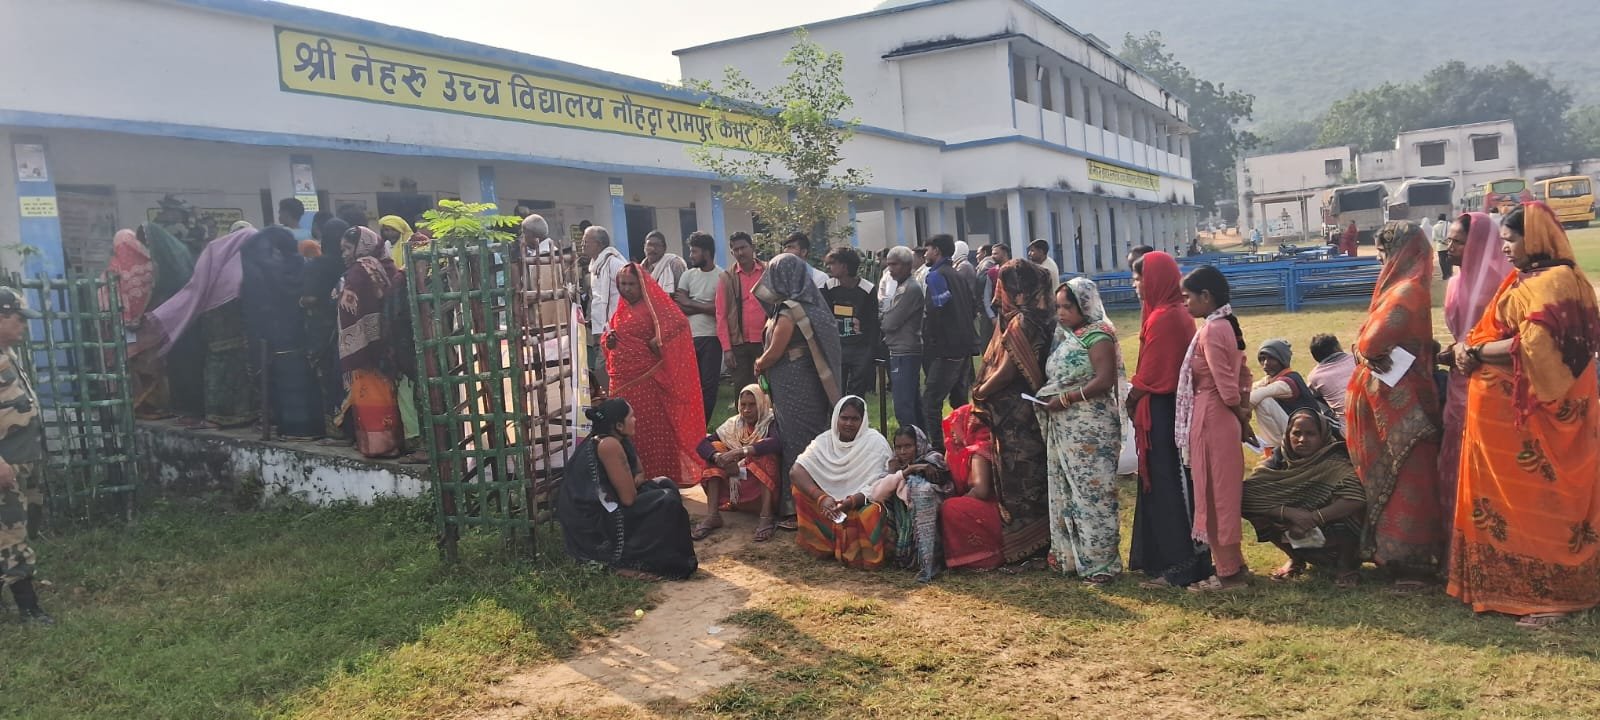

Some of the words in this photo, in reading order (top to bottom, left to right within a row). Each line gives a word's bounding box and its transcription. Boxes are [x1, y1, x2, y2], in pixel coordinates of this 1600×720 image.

[294, 38, 336, 82] श्री
[437, 70, 501, 105] उच्च
[508, 74, 604, 119] विद्यालय
[667, 110, 714, 142] रामपुर
